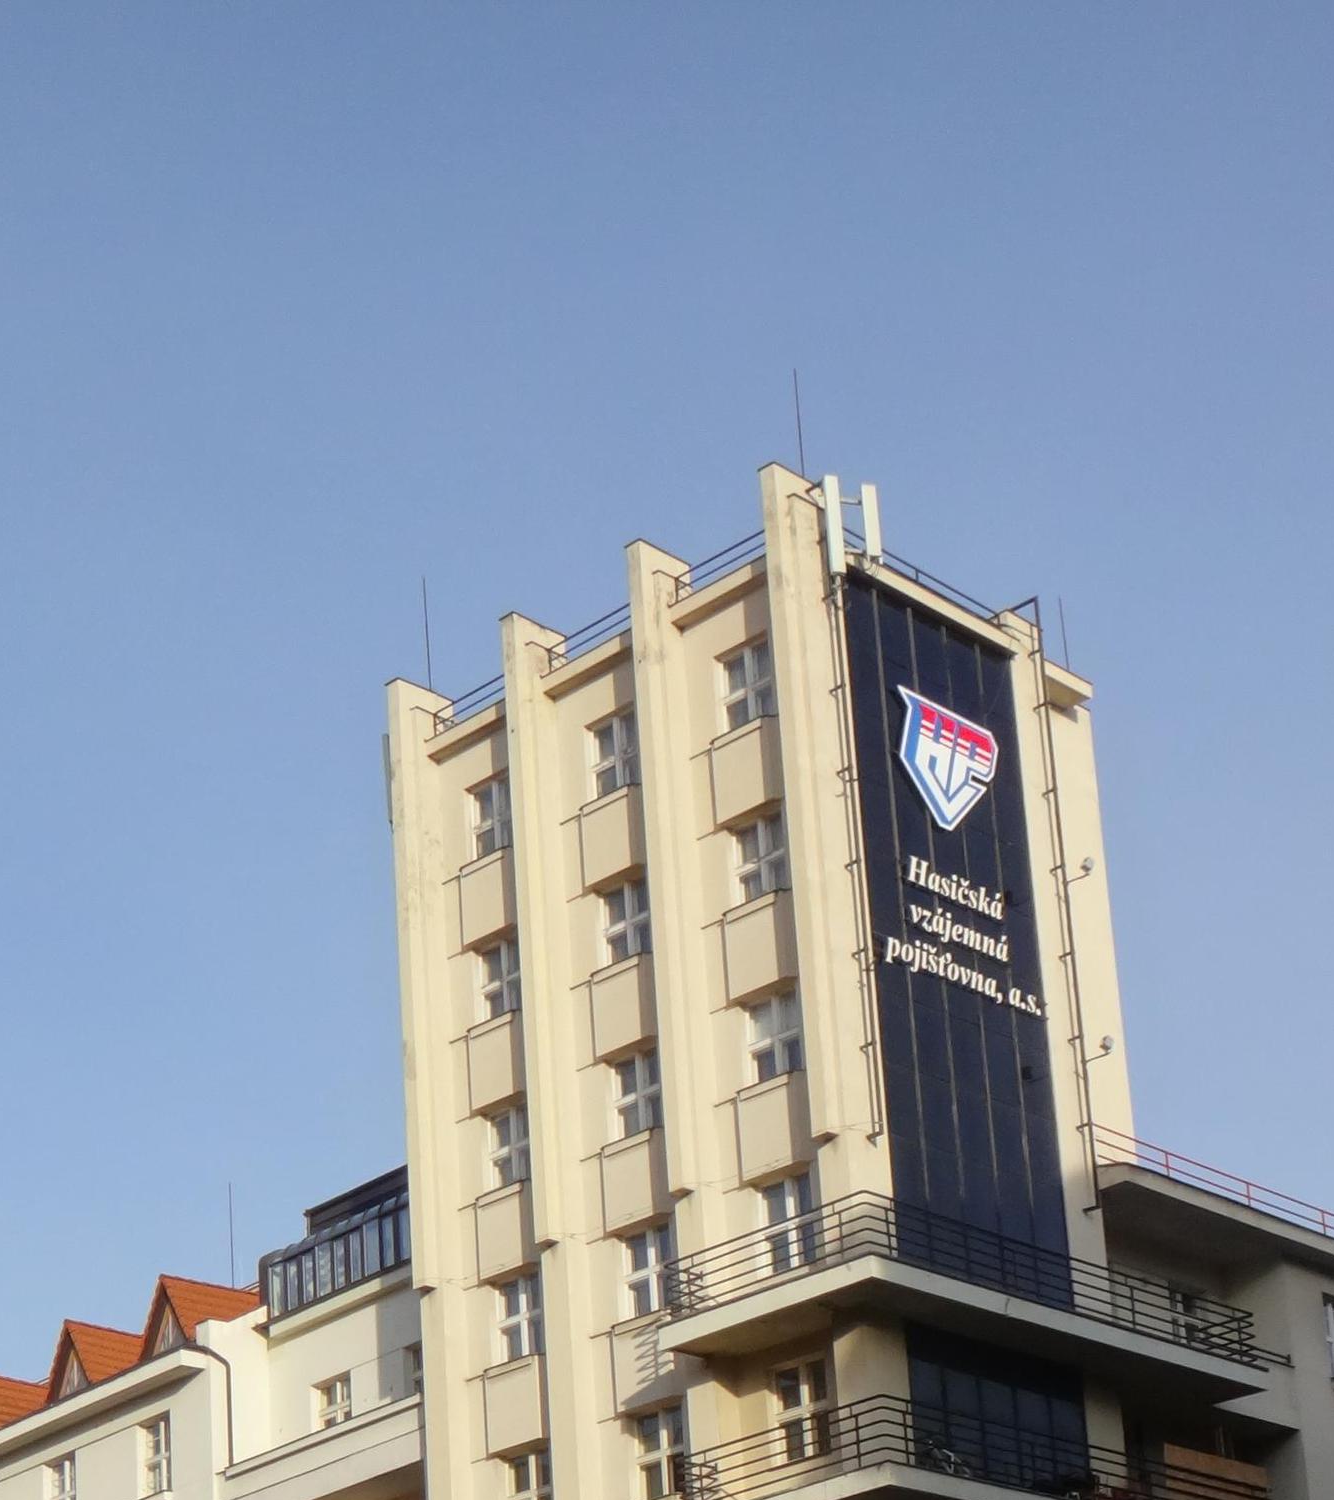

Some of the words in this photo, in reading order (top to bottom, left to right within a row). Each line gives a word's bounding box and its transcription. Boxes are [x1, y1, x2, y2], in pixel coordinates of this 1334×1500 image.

[907, 855, 1005, 921] Hasičská
[909, 902, 1009, 962] vzájemná
[885, 936, 1004, 1005] pojišťovna,
[1008, 986, 1043, 1016] a.s.
